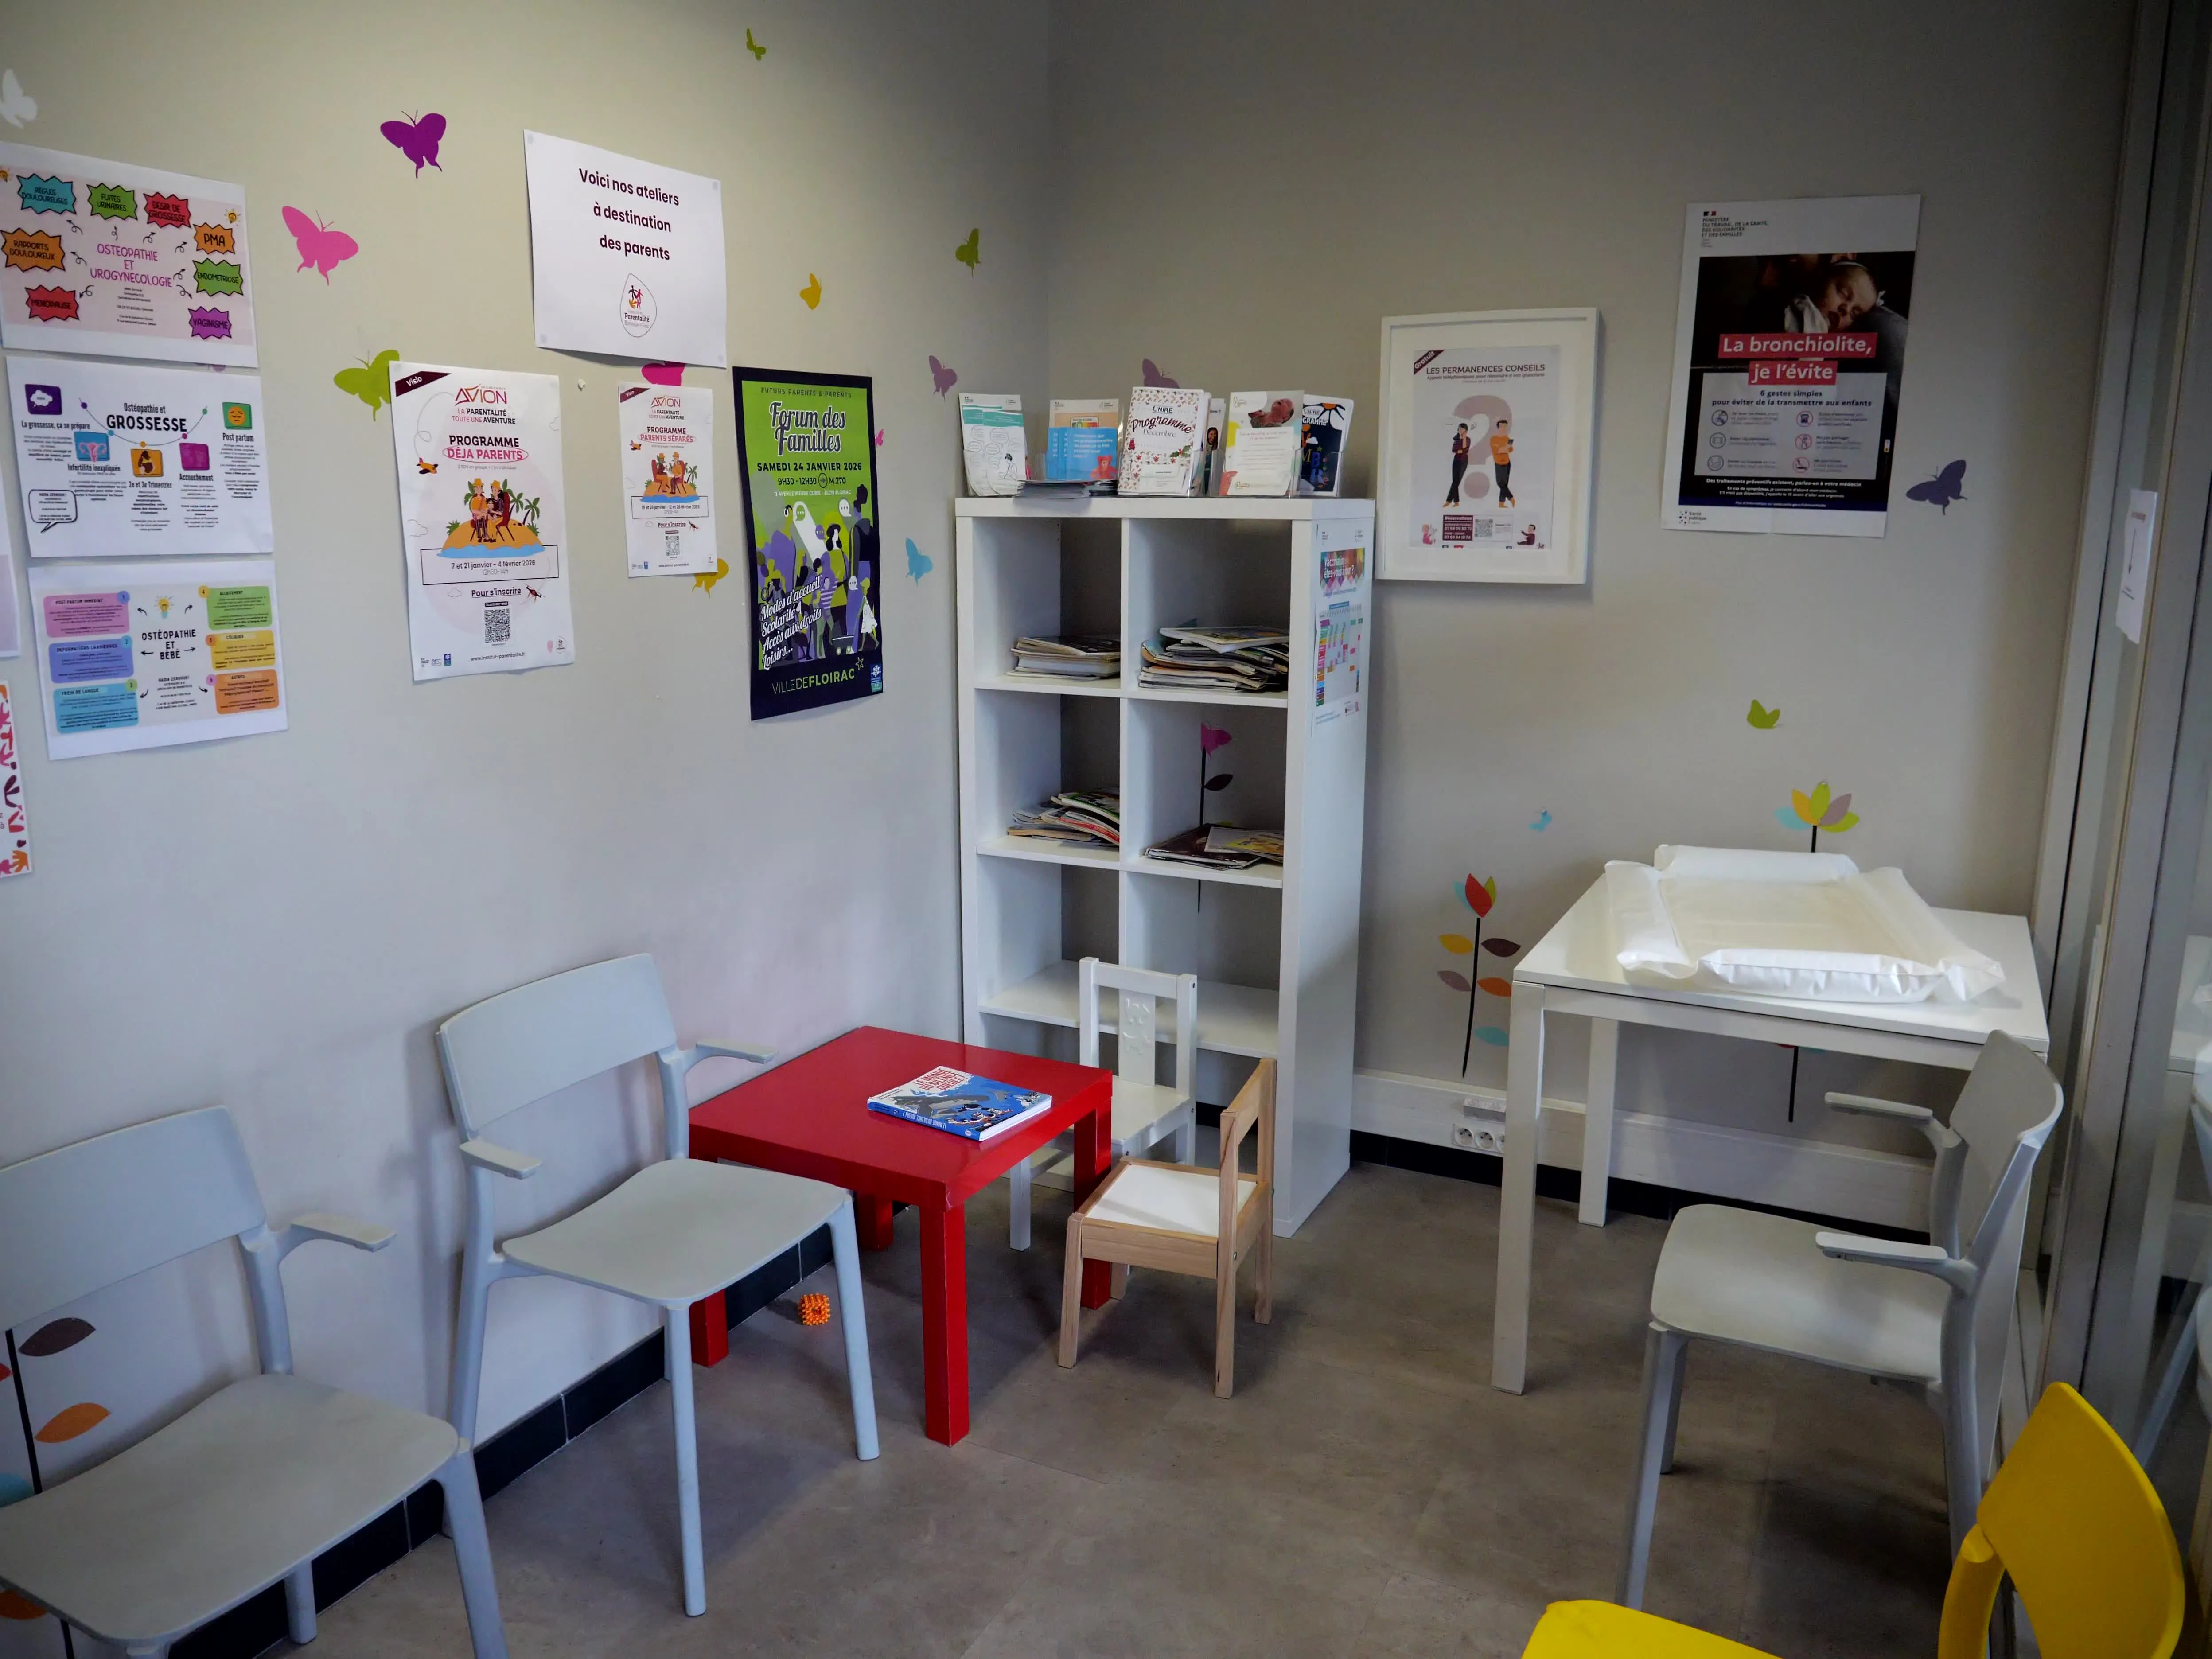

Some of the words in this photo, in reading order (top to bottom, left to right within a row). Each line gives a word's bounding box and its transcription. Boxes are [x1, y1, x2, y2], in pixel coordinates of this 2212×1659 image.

[579, 168, 610, 188] Voici
[612, 180, 633, 194] nos
[636, 185, 679, 206] ateliers
[101, 193, 121, 203] FUITES
[97, 202, 127, 212] URINAIRES
[148, 210, 187, 222] GROSSESSE
[593, 201, 601, 217] à
[604, 206, 671, 232] destination
[14, 240, 49, 251] RAPPORTS
[204, 233, 225, 246] PMA
[10, 248, 55, 260] DOULOUREUX
[97, 244, 158, 261] OSTEOPATHIE
[600, 235, 621, 251] des
[624, 241, 670, 260] parents
[124, 260, 134, 270] ET
[90, 268, 172, 287] UROGYNECOLOGIE
[198, 272, 239, 284] ENDOMETRIOSE
[193, 317, 228, 330] VAGINISME
[624, 312, 650, 323] Parentalité
[1723, 338, 1743, 352] La
[1750, 336, 1872, 355] bronchiolite,
[1414, 350, 1435, 369] Gratuit
[1443, 366, 1503, 374] PERMANENCES
[1751, 364, 1770, 384] je
[1776, 363, 1833, 379] l'évite
[406, 376, 422, 387] Visio
[455, 384, 507, 406] AVION
[124, 402, 159, 415] Ostéopathie
[651, 396, 681, 408] AVION
[769, 401, 819, 431] Forum
[822, 405, 846, 429] des
[71, 422, 90, 431] prépare
[107, 414, 187, 432] GROSSESSE
[222, 432, 234, 441] Post
[236, 434, 254, 443] partum
[449, 435, 519, 448] PROGRAMME
[775, 426, 841, 456] Familles
[447, 447, 474, 459] DÉJA
[475, 449, 523, 460] PARENTS
[93, 464, 121, 474] inexpliquée
[757, 462, 791, 471] SAMEDI
[794, 463, 803, 471] 24
[806, 463, 841, 471] JANVIER
[471, 561, 492, 570] janvier
[490, 587, 521, 596] s'inscrire
[761, 600, 786, 621] Modes
[786, 576, 820, 604] d'accueil
[762, 605, 796, 637] Scolarité
[142, 629, 196, 640] OSTÉOPATHIE
[763, 630, 783, 655] Accès
[785, 622, 799, 639] aux
[798, 608, 822, 631] droits
[160, 649, 181, 660] BÉBÉ
[762, 645, 793, 670] Loisirs...
[921, 1068, 949, 1081] MONDE
[928, 1071, 960, 1086] SILENCE
[936, 1077, 965, 1090] GUEULE
